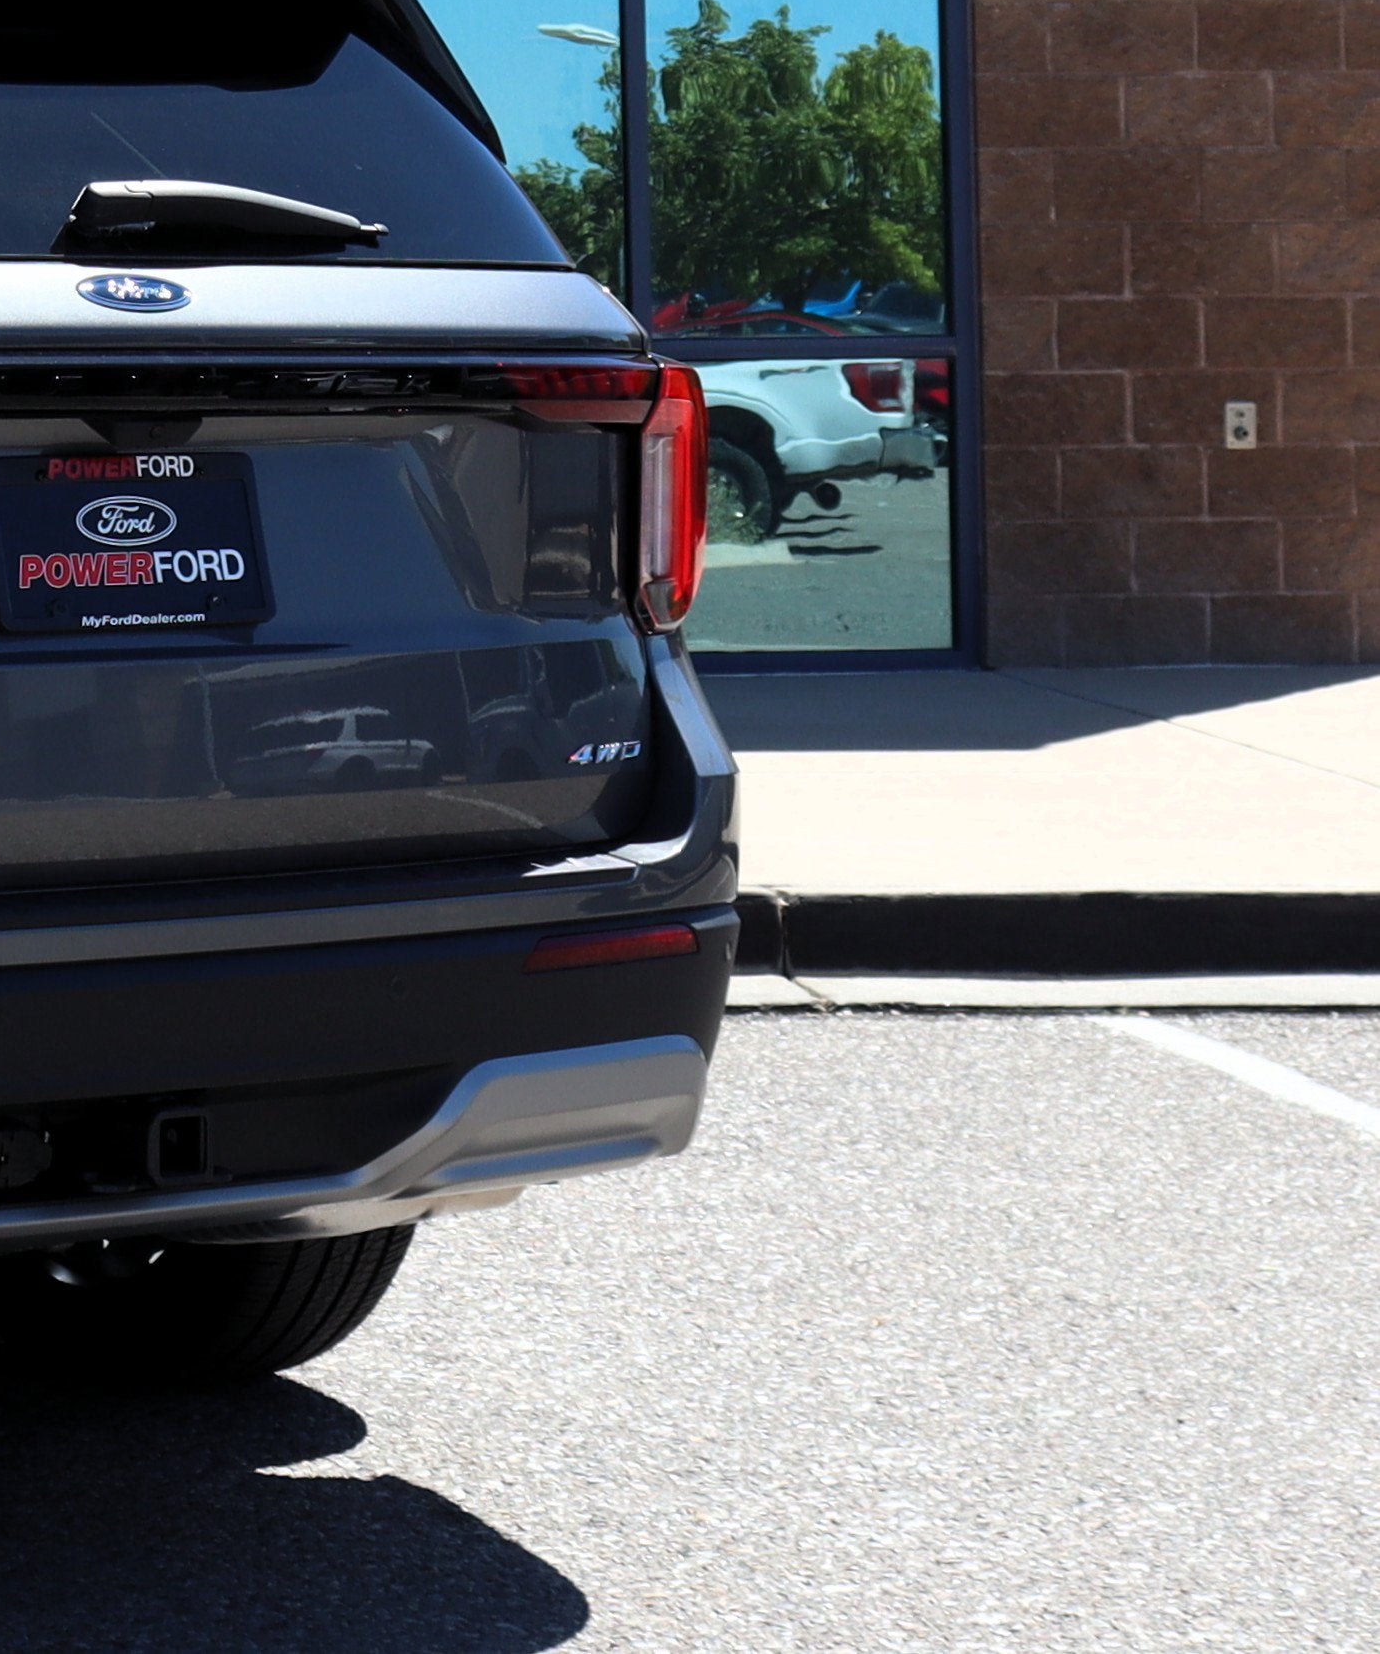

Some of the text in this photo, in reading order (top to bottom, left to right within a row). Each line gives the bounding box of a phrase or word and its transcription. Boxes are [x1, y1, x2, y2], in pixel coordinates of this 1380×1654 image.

[96, 504, 156, 534] Ford
[81, 612, 206, 627] MyFordDealer.com
[566, 740, 642, 765] 4WD
